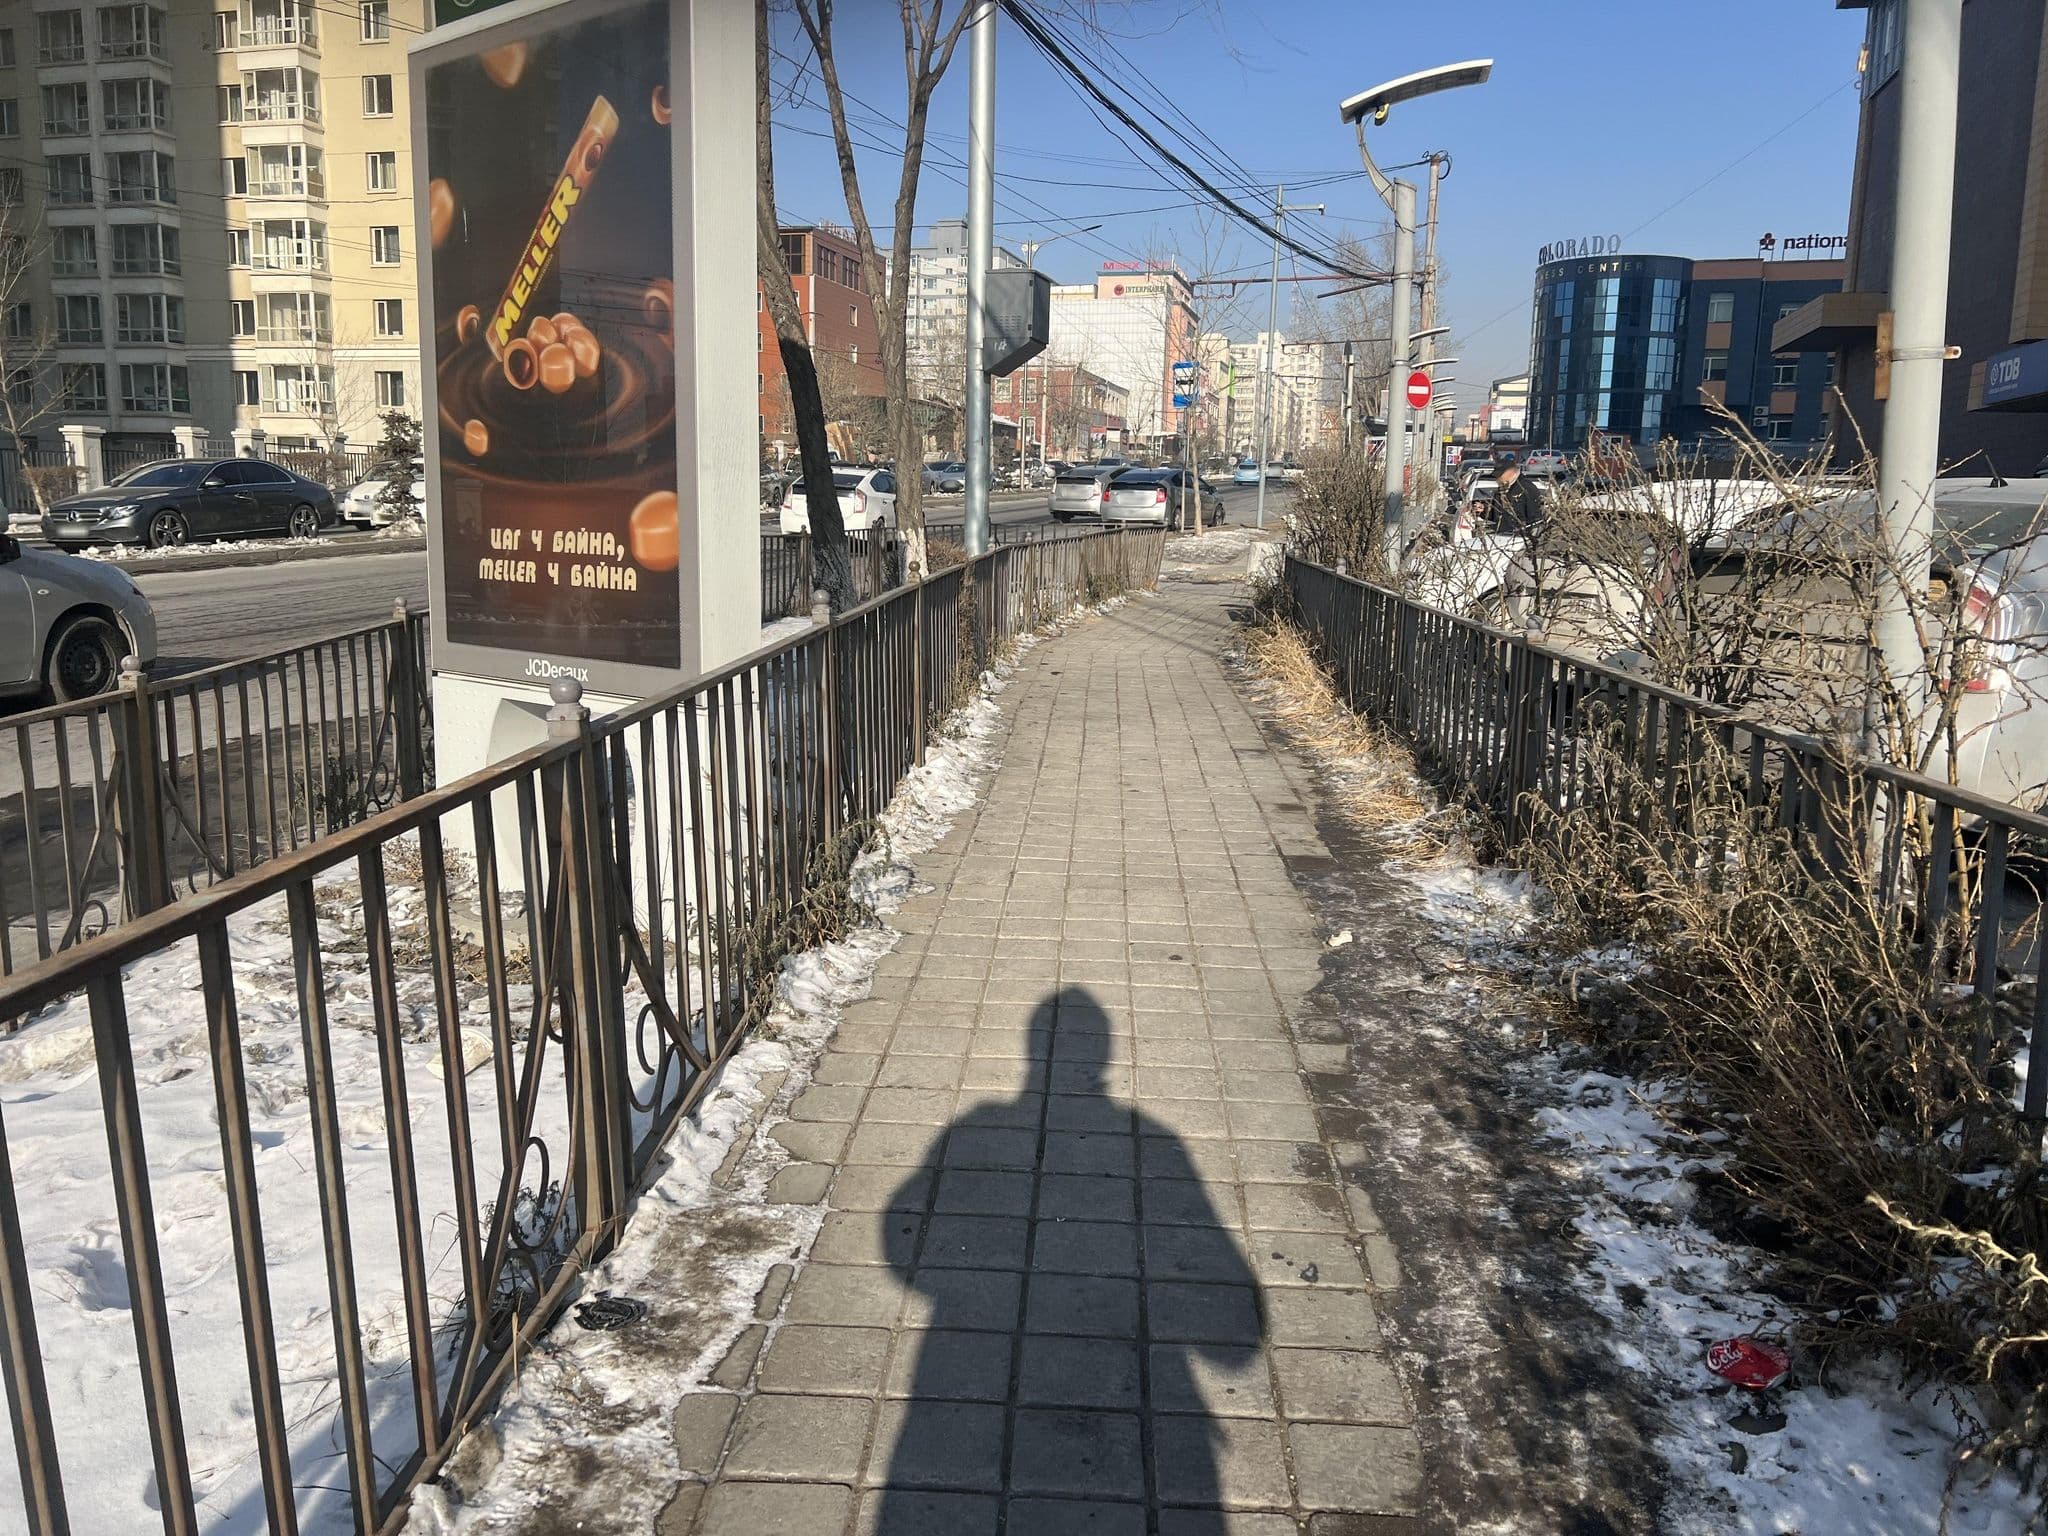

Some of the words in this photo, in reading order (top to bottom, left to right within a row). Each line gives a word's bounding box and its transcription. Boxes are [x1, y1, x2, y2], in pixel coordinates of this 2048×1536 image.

[495, 174, 582, 347] MELLER
[1999, 357, 2020, 383] TDB
[490, 527, 521, 550] ЦАГ
[553, 527, 624, 561] БАЙНА,
[479, 558, 536, 583] MELLER
[571, 562, 637, 591] БАЙНА
[525, 658, 589, 682] JCDecaux
